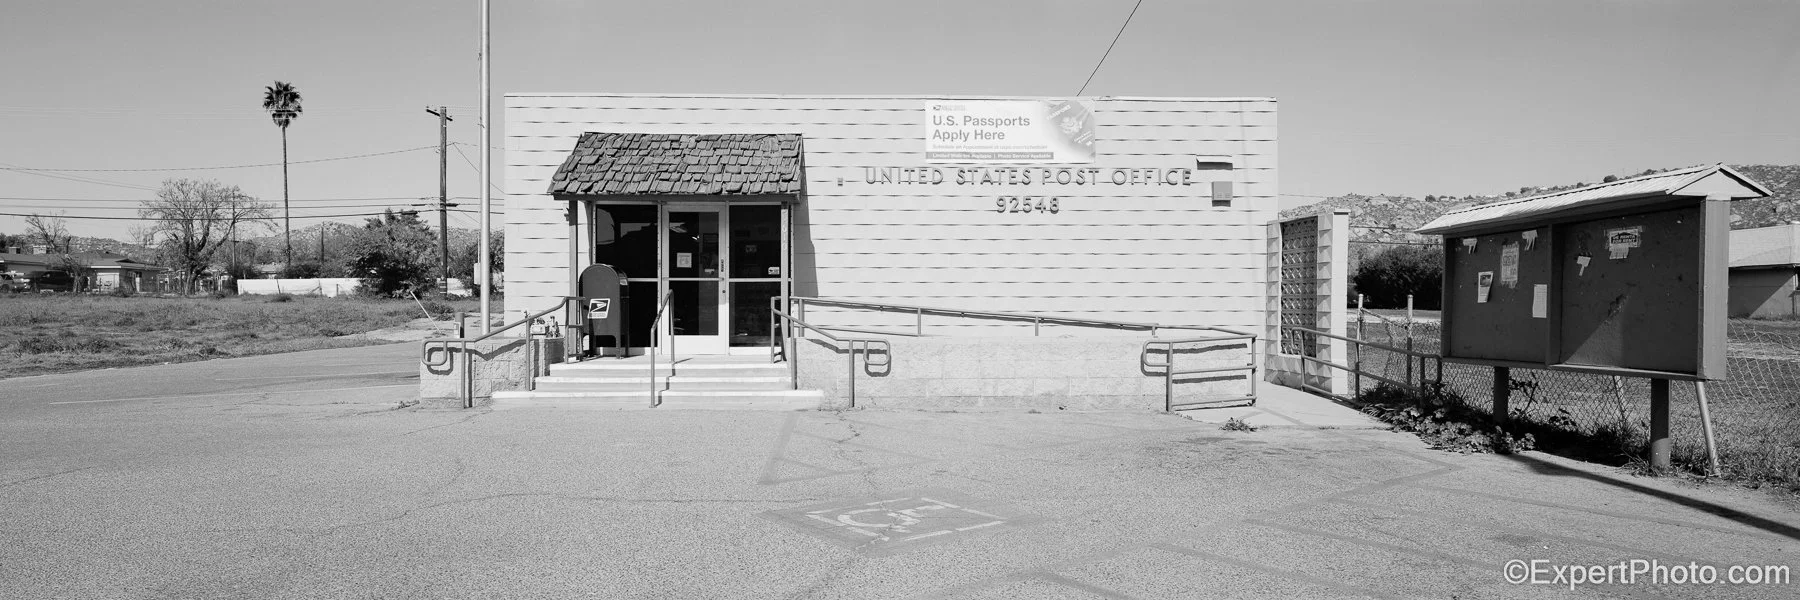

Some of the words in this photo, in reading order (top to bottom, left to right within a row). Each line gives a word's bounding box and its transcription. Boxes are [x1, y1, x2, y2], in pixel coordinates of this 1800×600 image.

[933, 115, 958, 126] U.S.
[963, 115, 1030, 128] Passports
[932, 129, 970, 142] Apply
[974, 129, 1005, 140] Here
[865, 167, 944, 185] UNITED
[956, 168, 1032, 185] STATES
[1042, 168, 1099, 186] POST
[1111, 168, 1191, 186] OFFICE
[996, 196, 1060, 214] 92548
